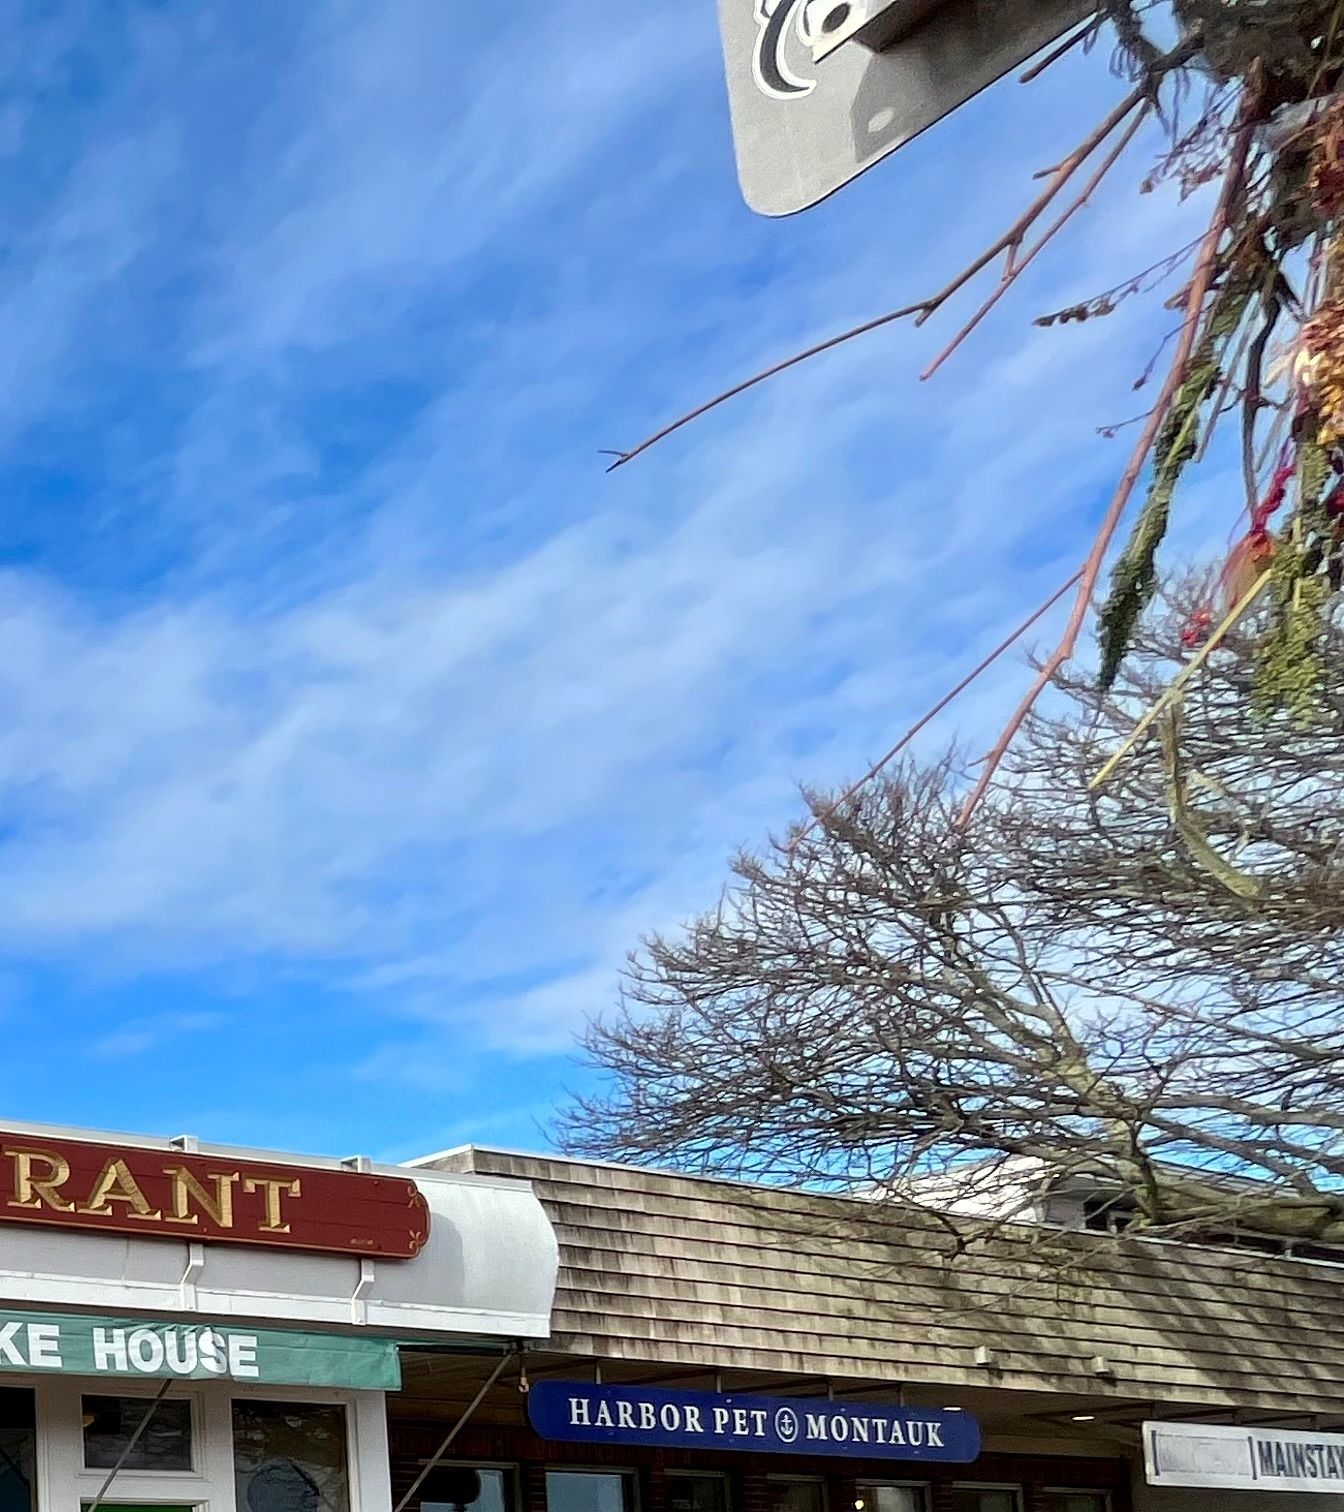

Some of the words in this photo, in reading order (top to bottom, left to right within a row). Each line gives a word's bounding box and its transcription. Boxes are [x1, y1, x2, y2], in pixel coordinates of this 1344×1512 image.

[92, 1326, 260, 1378] HOUSE
[568, 1397, 705, 1433] HARBOR
[713, 1407, 768, 1437] PET
[805, 1414, 944, 1447] MONTAUK
